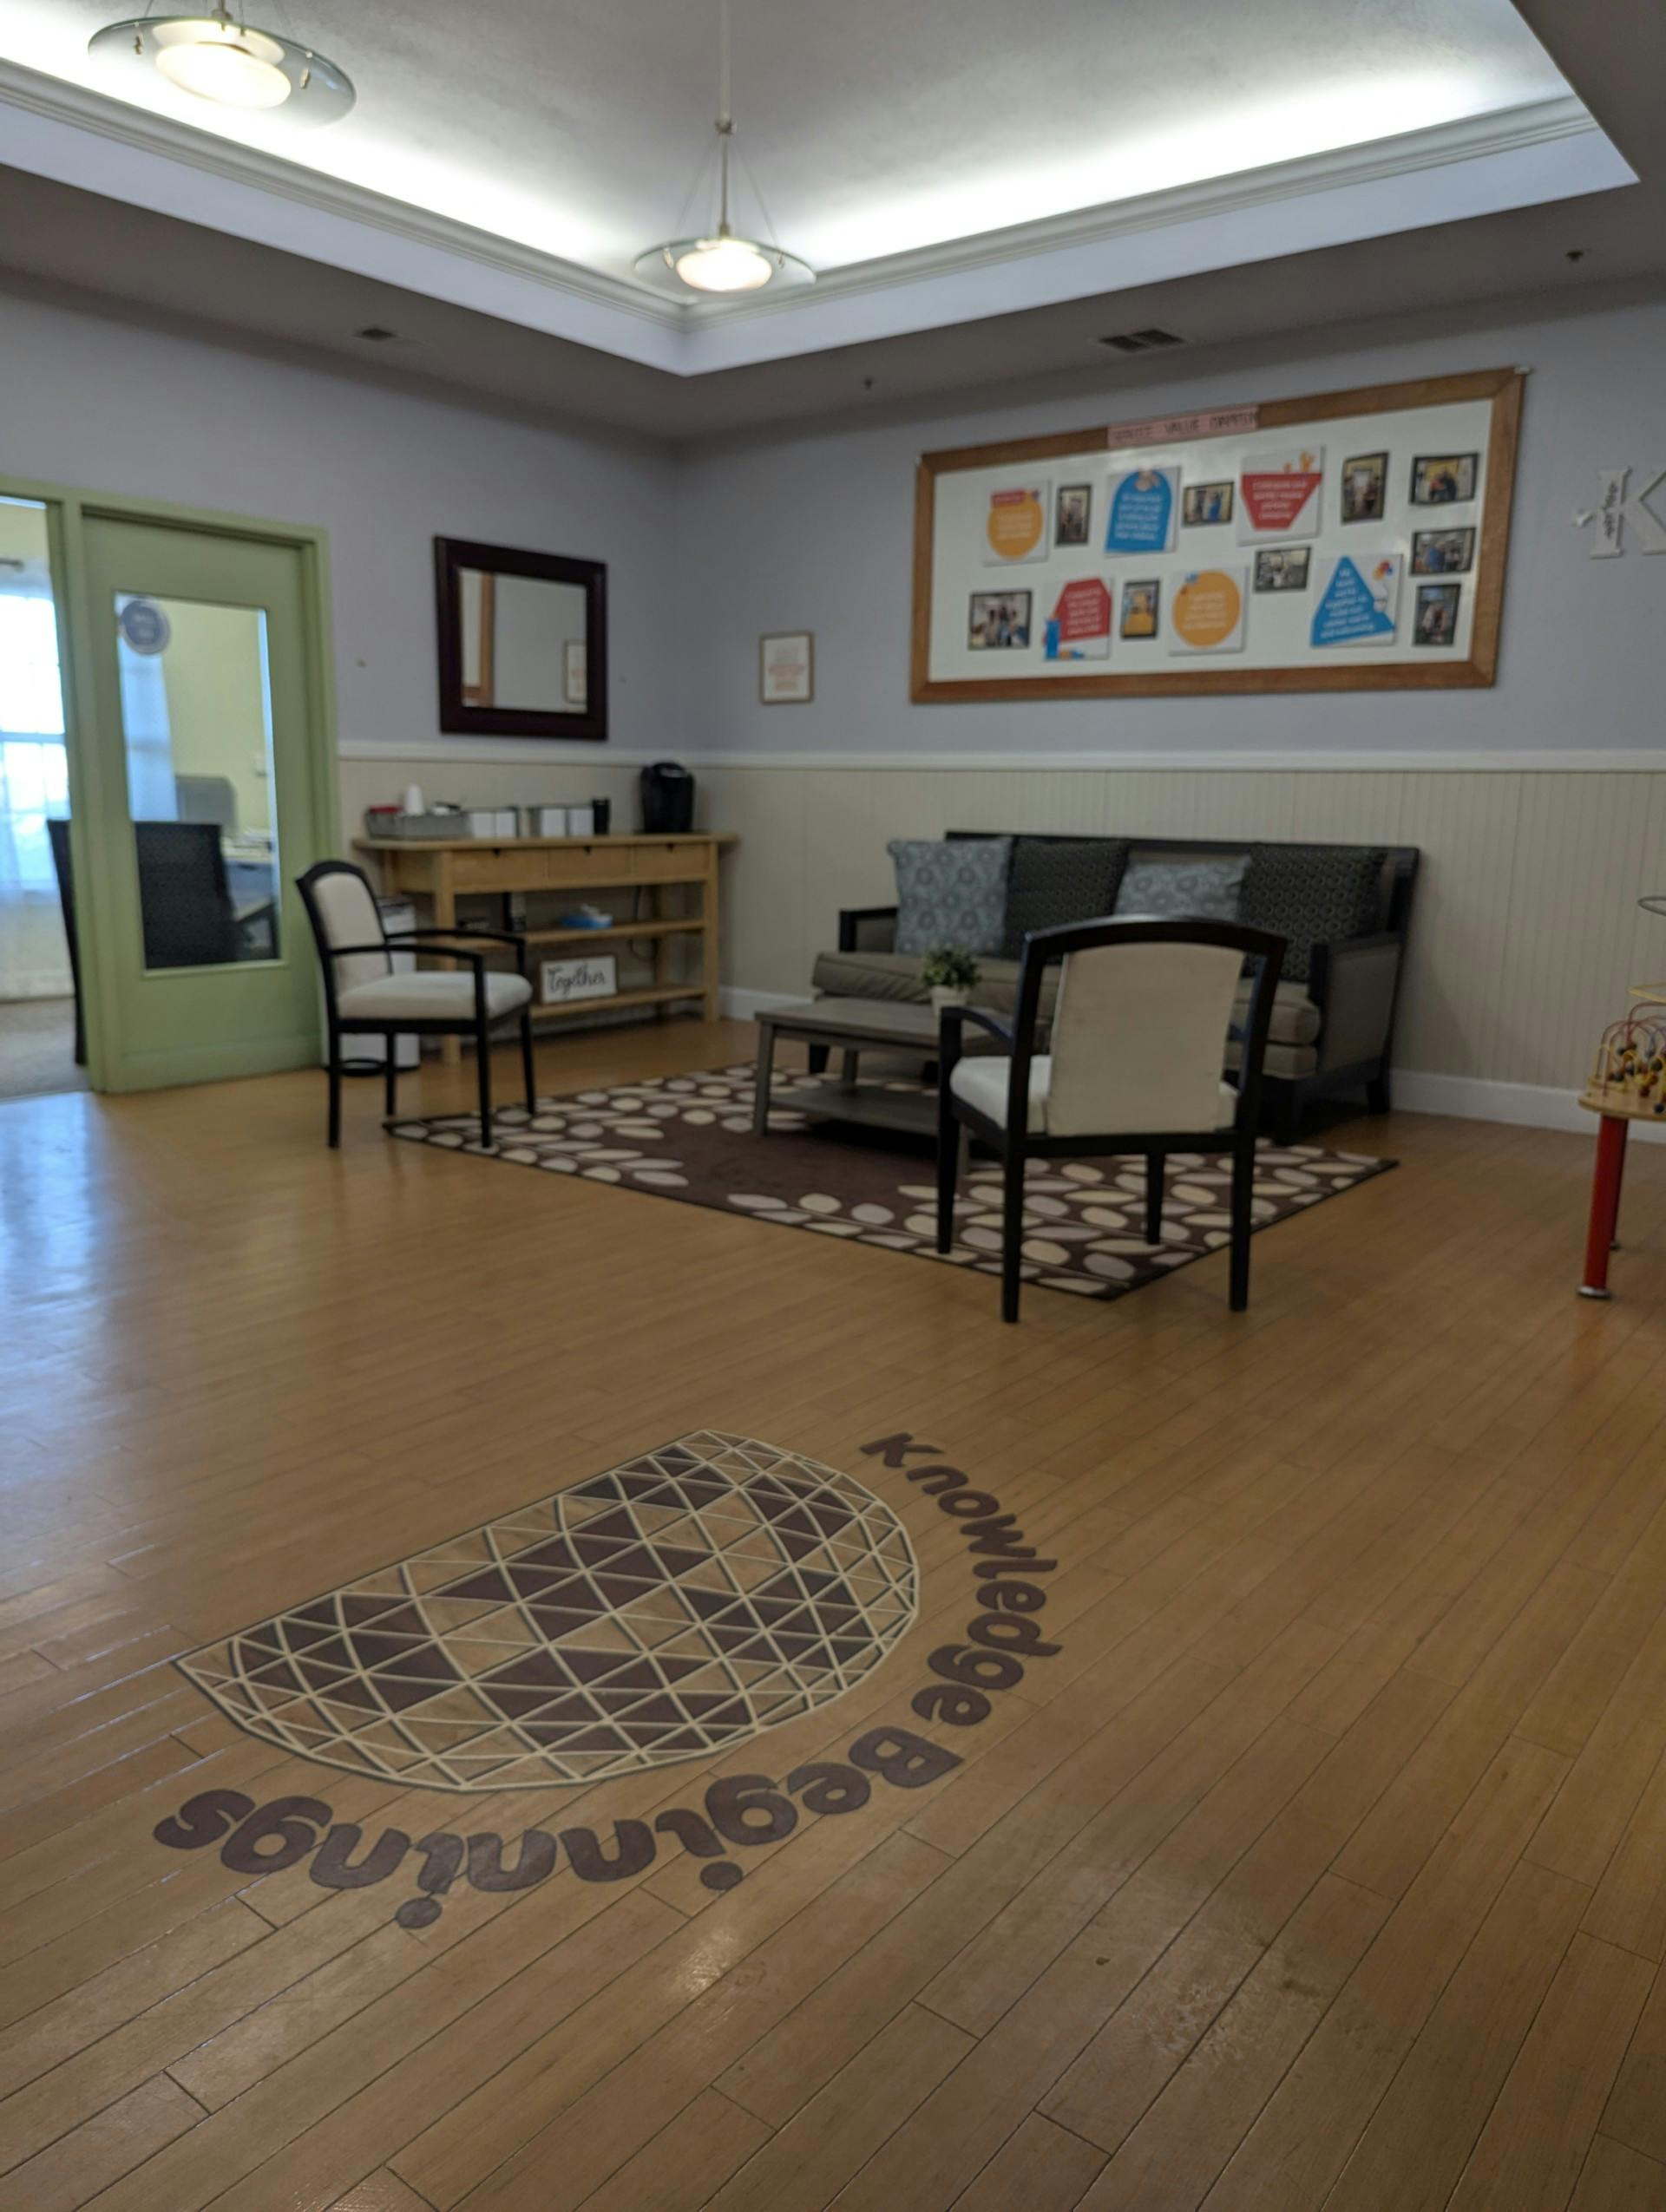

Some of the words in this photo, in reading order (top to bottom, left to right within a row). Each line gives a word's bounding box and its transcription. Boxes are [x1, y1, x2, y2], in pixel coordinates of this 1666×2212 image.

[548, 962, 607, 998] Together
[859, 1432, 1064, 1726] Knowledge
[152, 1725, 964, 1929] Beginnings
